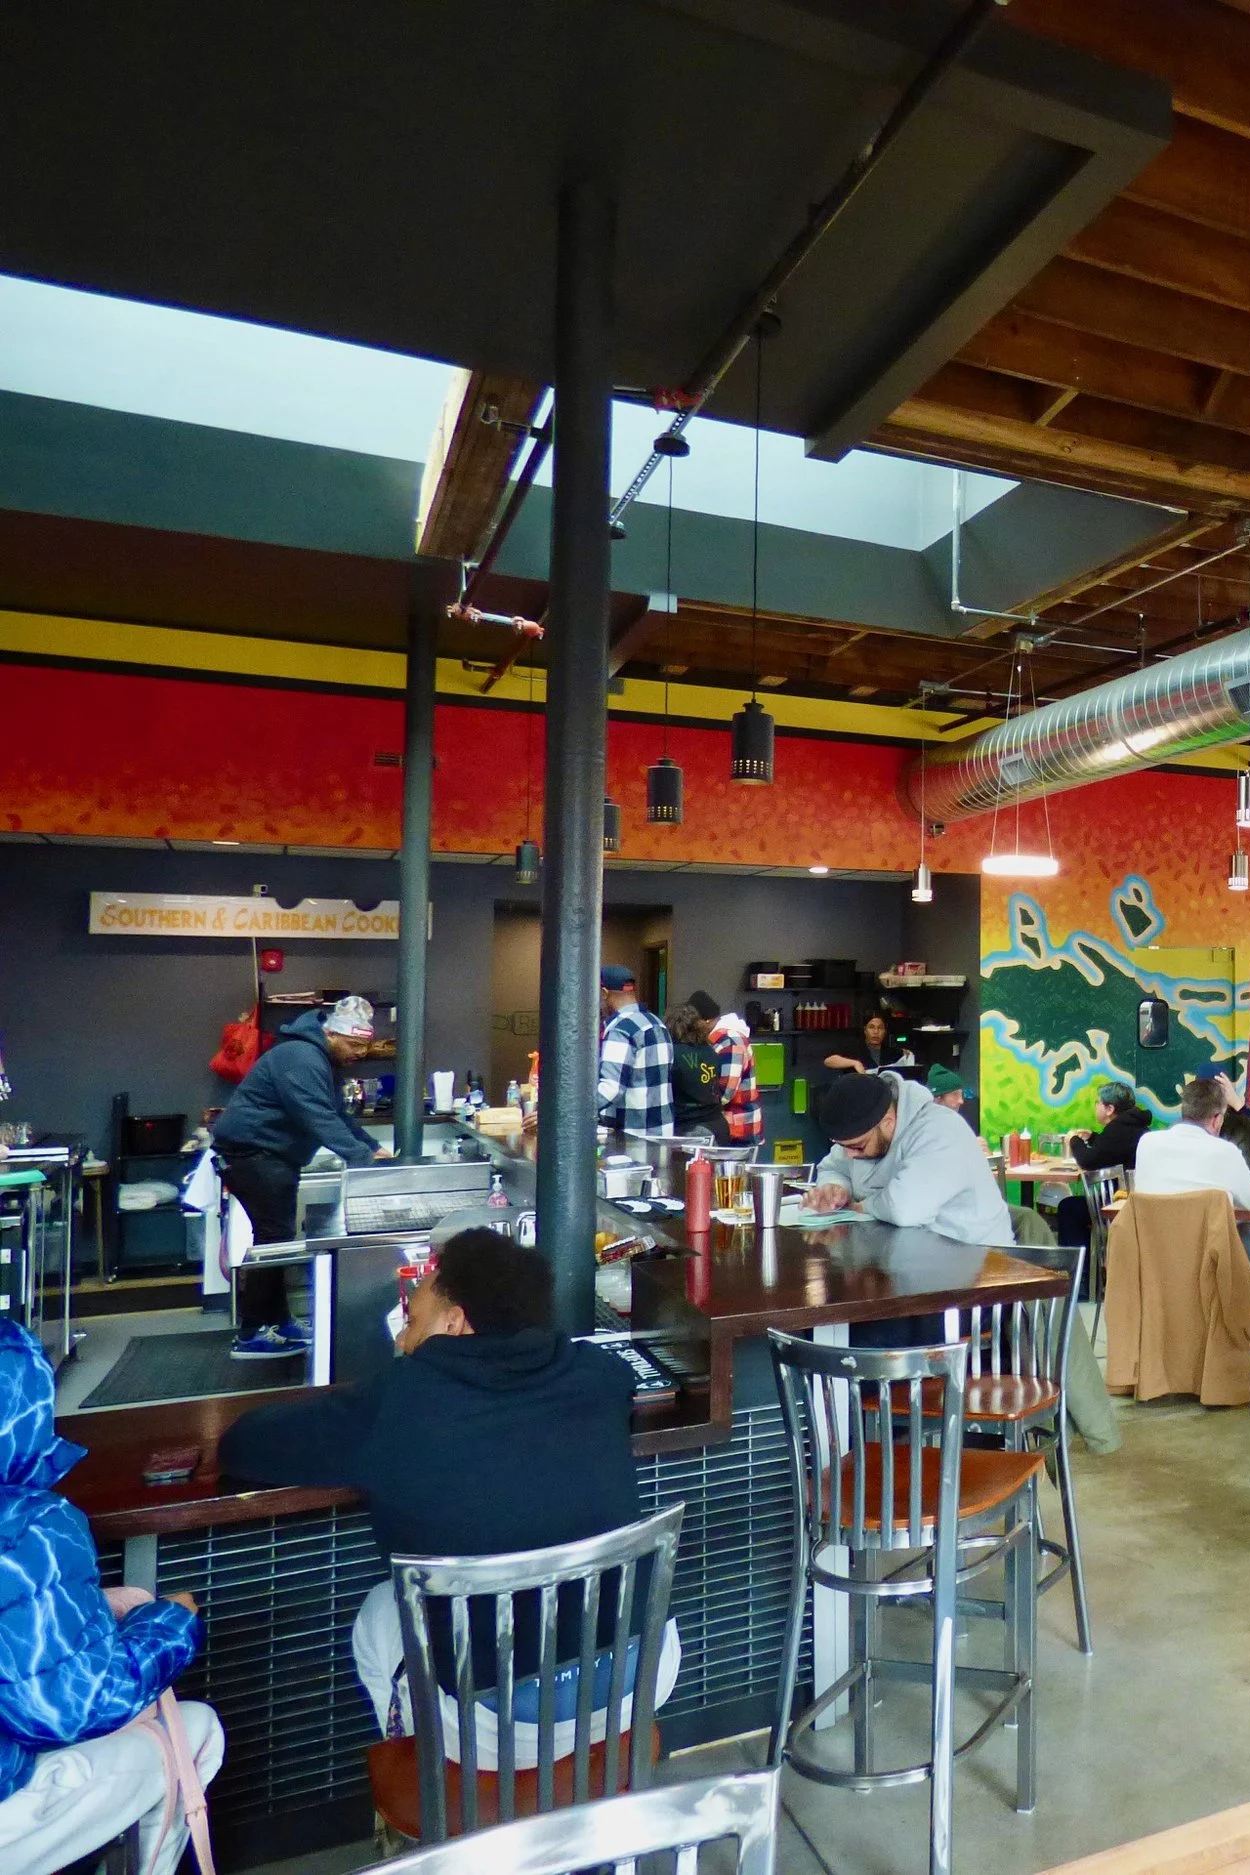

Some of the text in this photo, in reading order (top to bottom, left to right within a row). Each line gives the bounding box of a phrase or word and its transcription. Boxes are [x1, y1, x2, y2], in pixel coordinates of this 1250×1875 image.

[101, 905, 207, 929] SOUTHERN
[212, 907, 226, 930] &
[233, 908, 337, 931] CARIBBEAN
